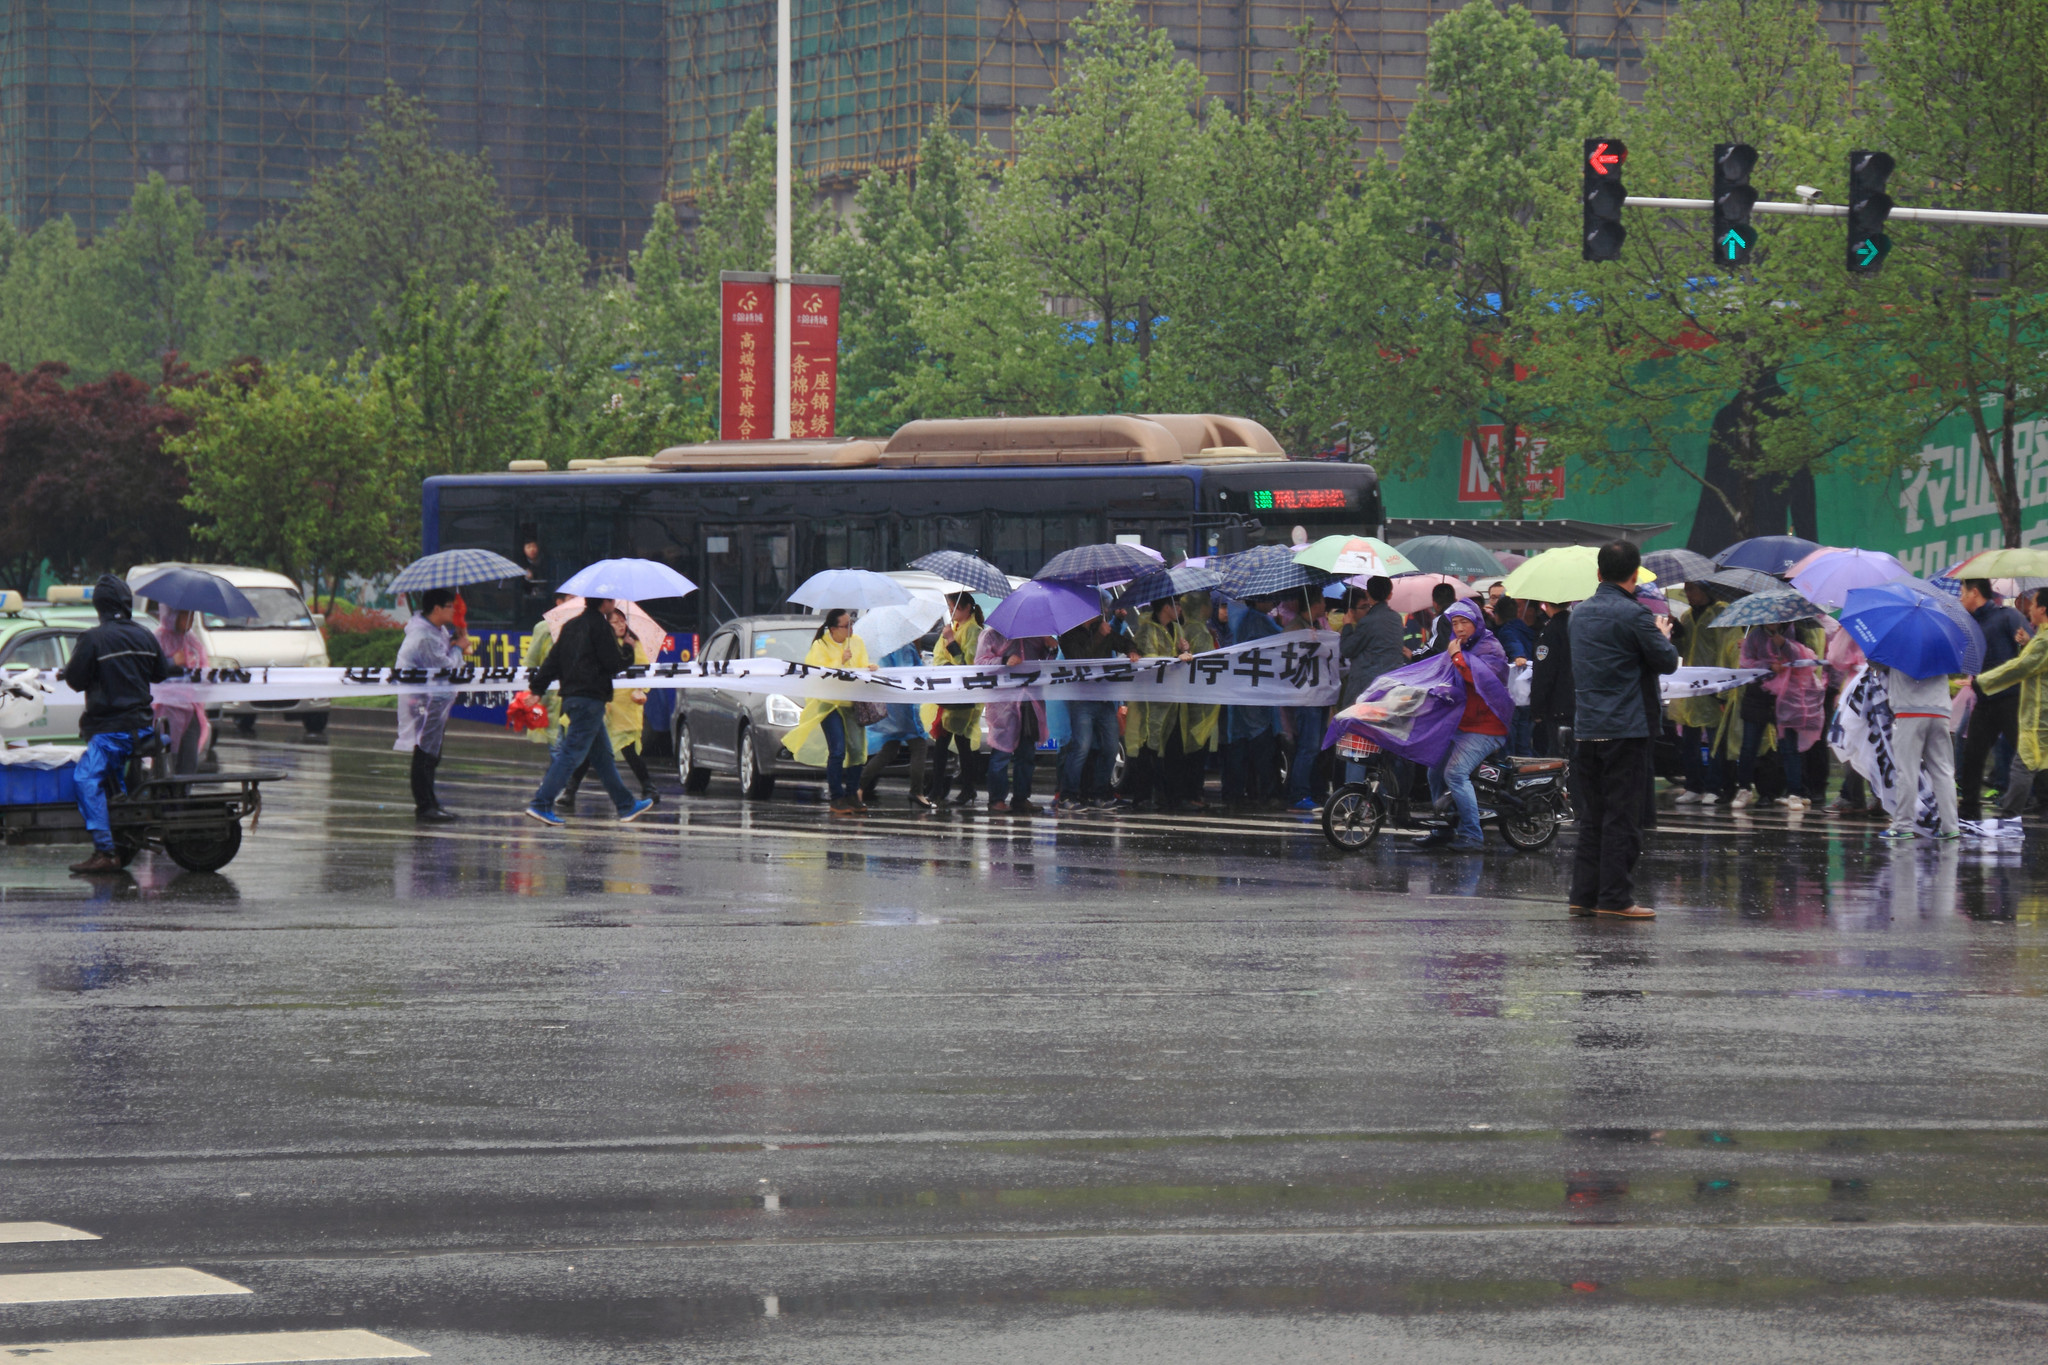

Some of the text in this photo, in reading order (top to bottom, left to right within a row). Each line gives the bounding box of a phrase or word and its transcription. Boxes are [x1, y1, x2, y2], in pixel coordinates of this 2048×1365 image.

[739, 332, 756, 440] 高端城市综合
[791, 341, 810, 438] 一条棉纺路
[812, 358, 831, 438] 一座锦绣
